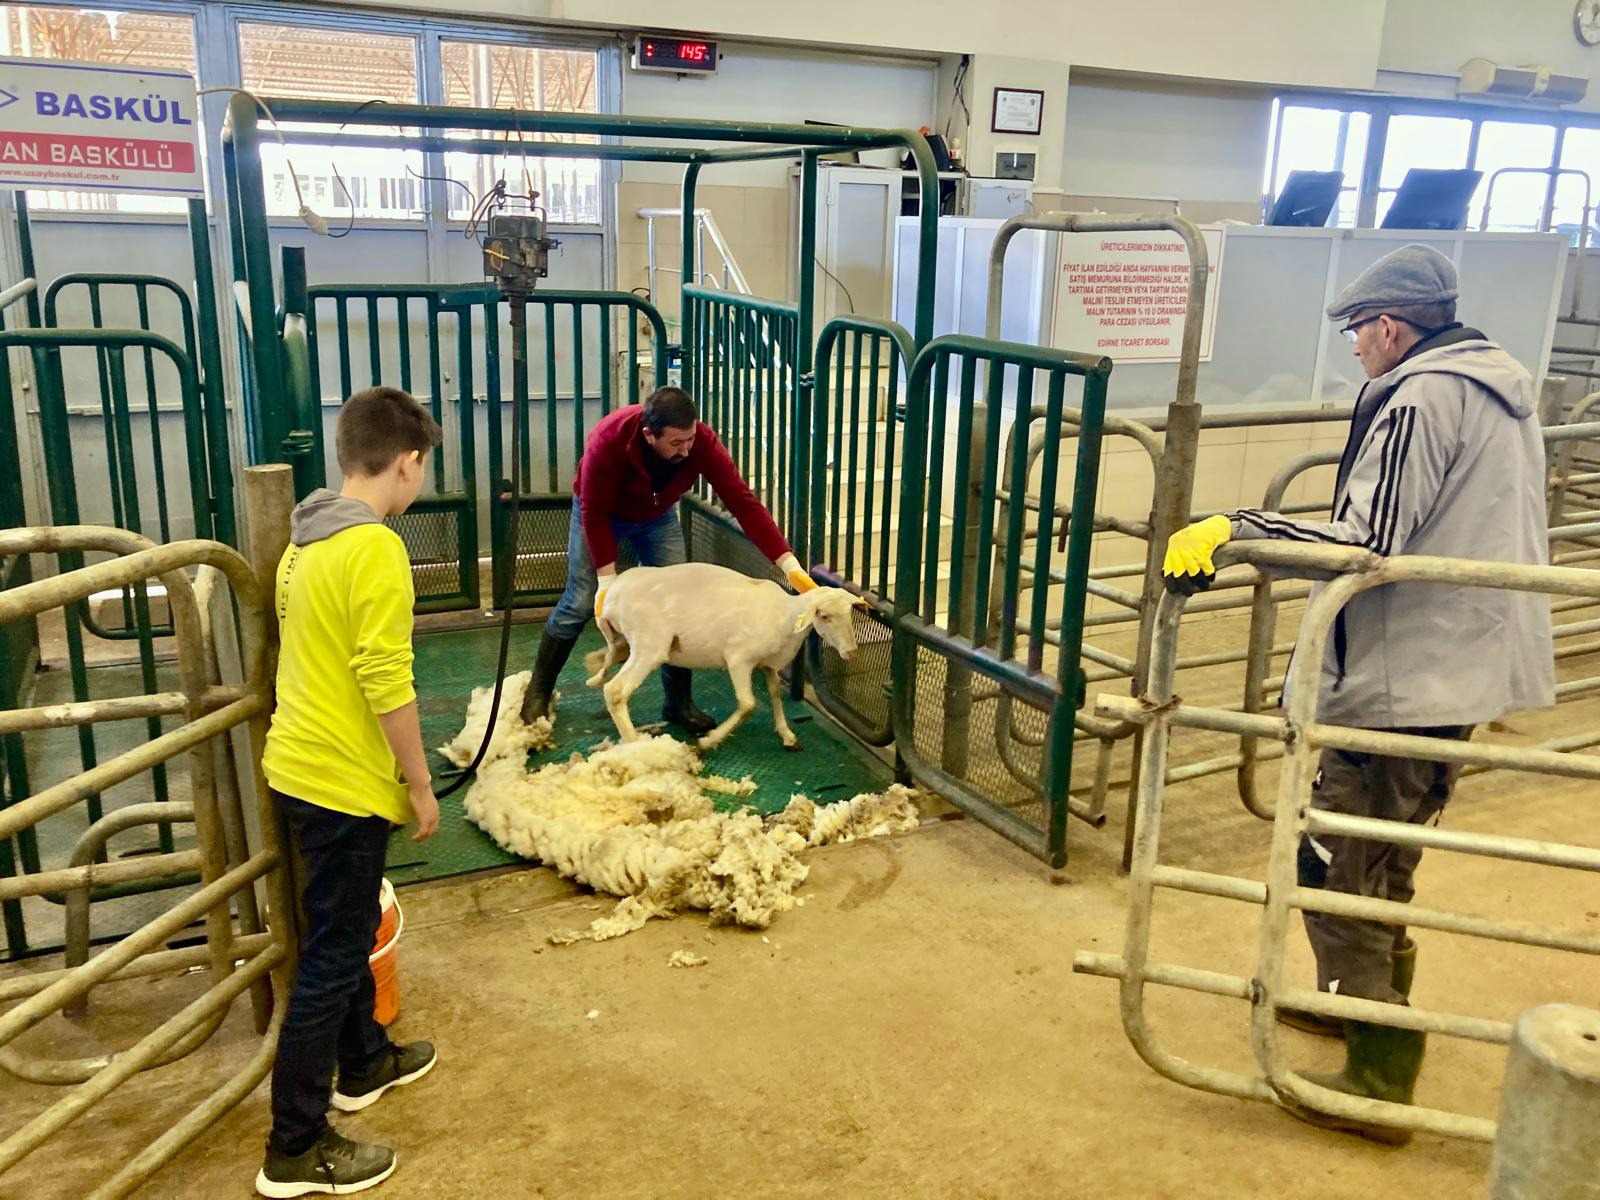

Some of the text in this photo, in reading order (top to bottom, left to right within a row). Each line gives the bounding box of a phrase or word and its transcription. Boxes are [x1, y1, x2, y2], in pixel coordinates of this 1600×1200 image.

[681, 45, 705, 60] 145
[35, 91, 192, 126] BASKÜL
[0, 140, 174, 169] AN BASKÜLÜ
